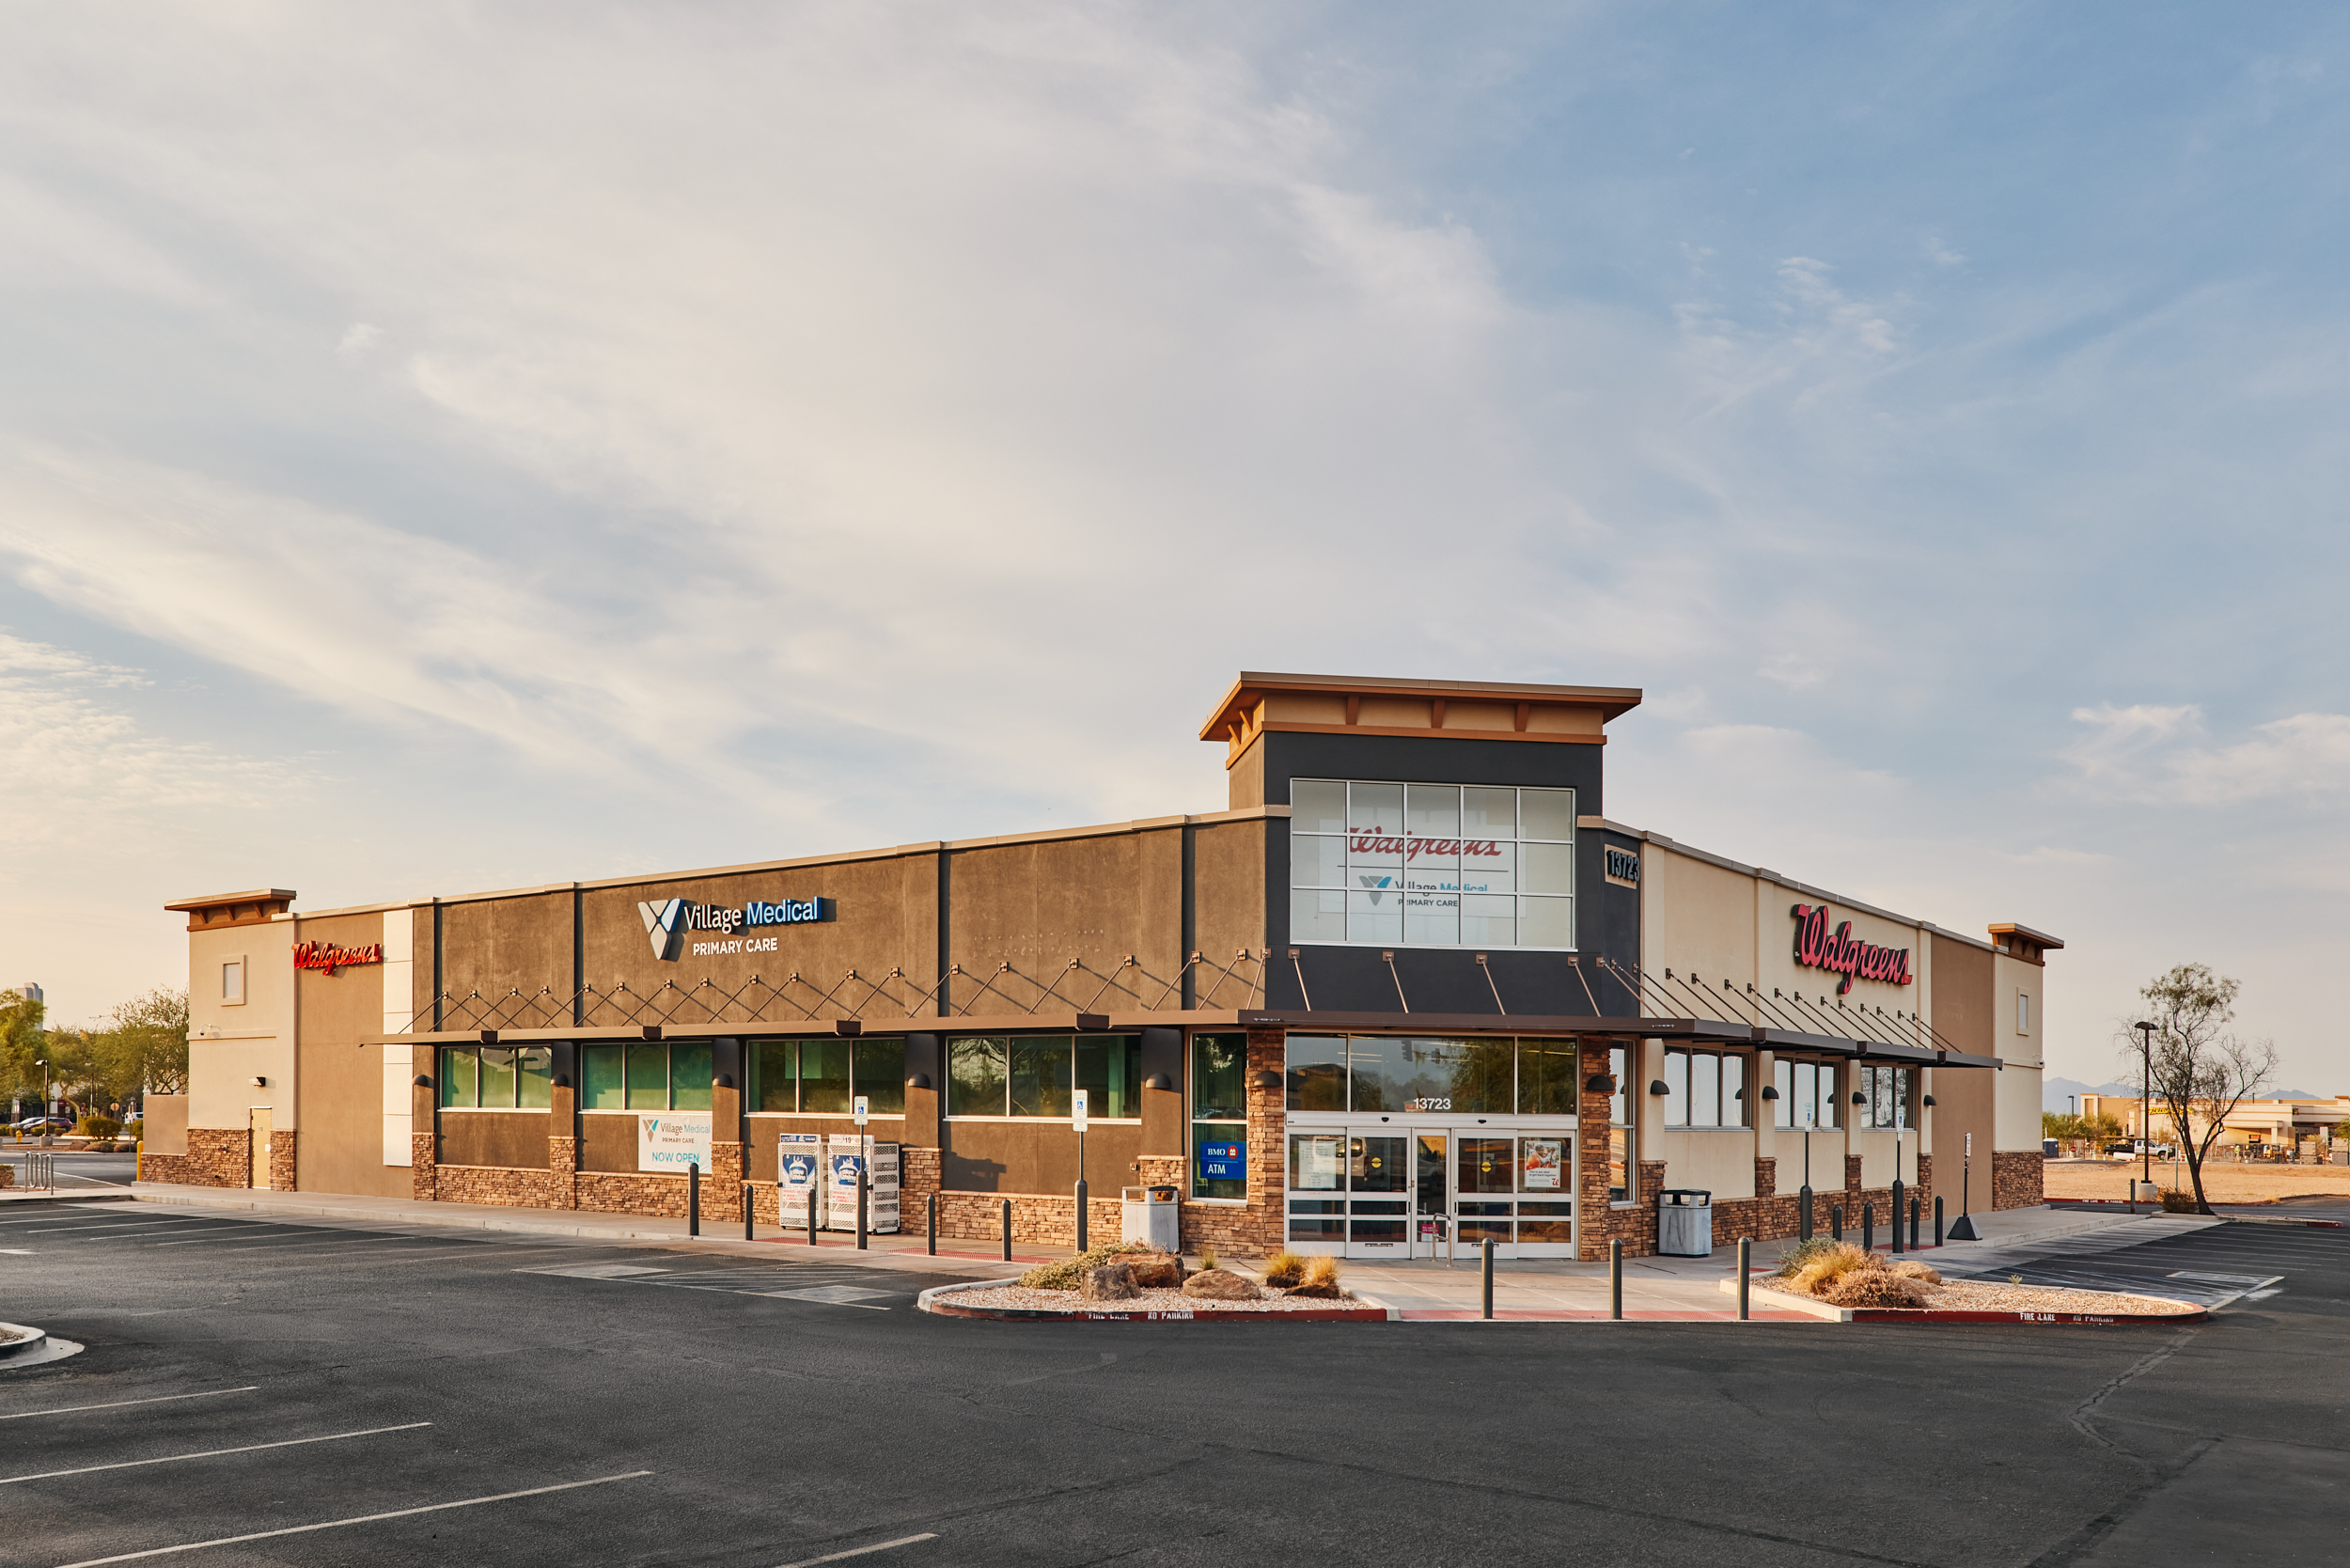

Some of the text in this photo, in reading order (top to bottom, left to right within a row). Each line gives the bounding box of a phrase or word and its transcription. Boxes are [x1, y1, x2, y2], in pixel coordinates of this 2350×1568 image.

[1609, 850, 1640, 882] 13723
[1398, 899, 1434, 907] PIMARY
[683, 896, 821, 935] Village Medical
[693, 937, 778, 956] PRIMARY CARE
[1795, 903, 1914, 995] Walgreens
[291, 940, 381, 976] Walgreens
[1413, 1097, 1451, 1110] 13723
[660, 1123, 711, 1136] Village Medical
[651, 1152, 699, 1164] NOW OPEN
[1207, 1148, 1226, 1156] BMO
[1207, 1163, 1227, 1174] ATM
[2019, 1312, 2035, 1321] FIRE
[2037, 1312, 2057, 1322] LANE
